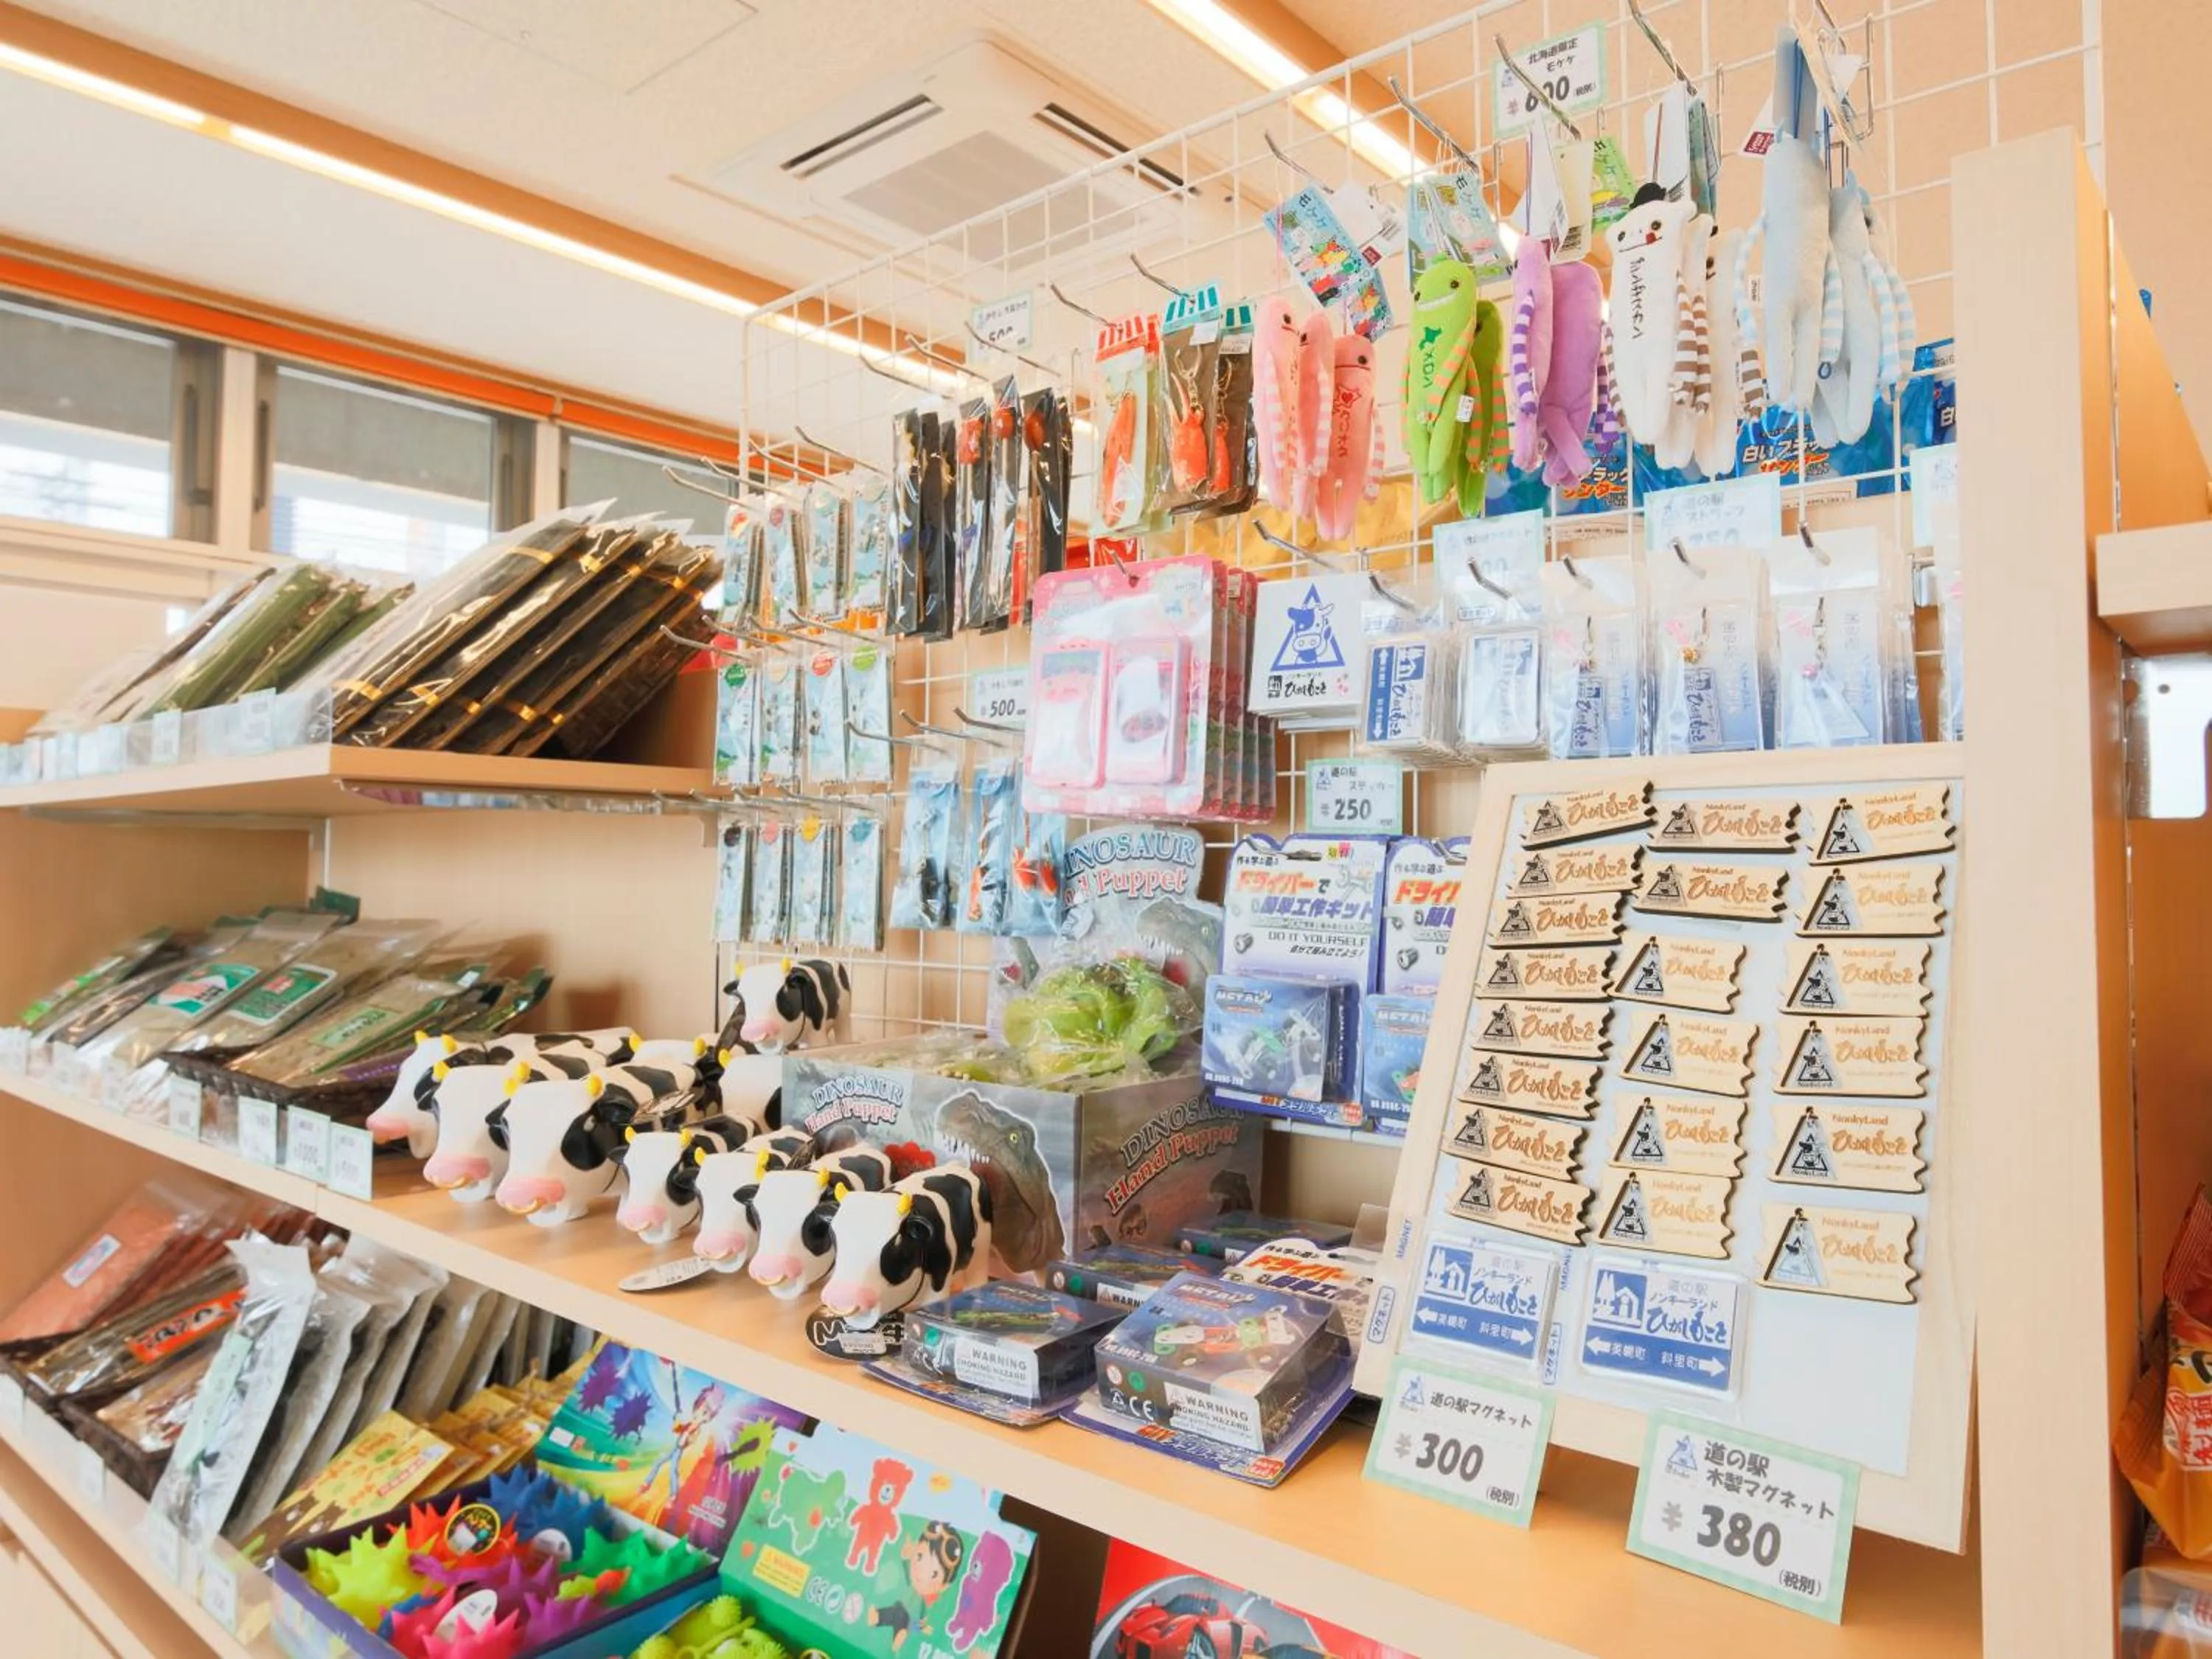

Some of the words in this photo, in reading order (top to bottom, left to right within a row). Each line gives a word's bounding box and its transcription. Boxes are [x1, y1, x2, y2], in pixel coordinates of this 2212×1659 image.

[1547, 55, 1576, 72] モケケ
[1940, 406, 1956, 428] 白
[1743, 439, 1820, 463] 白いブラッ
[990, 698, 1015, 718] 500
[1335, 798, 1371, 821] 250
[1065, 830, 1196, 880] INOSAUR
[1094, 867, 1187, 900] Puppet
[1260, 896, 1373, 920] 簡単工作キット
[1268, 931, 1285, 941] DO
[1290, 932, 1298, 942] IT
[1304, 933, 1368, 947] YOURSELF
[811, 1073, 904, 1110] DINOSAUR
[841, 1096, 897, 1125] Puppet
[1105, 1142, 1169, 1215] Hand
[1170, 1123, 1239, 1163] Puppet
[1395, 1219, 1412, 1259] MAGNET
[1474, 1266, 1534, 1284] ノンキーランド
[1668, 1279, 1708, 1292] 道の駅
[1469, 1279, 1537, 1315] ひがしもこと
[1649, 1292, 1719, 1312] ノンキーランド
[1372, 1291, 1392, 1337] マグネット
[1646, 1307, 1727, 1343] ひがしもこと
[972, 1347, 1027, 1370] WARNING
[1545, 1327, 1560, 1378] マグネット
[1660, 1351, 1698, 1370] 斜里町
[1186, 1395, 1249, 1422] WARNING
[1430, 1391, 1533, 1429] 道の駅マグネット
[1704, 1440, 1770, 1478] 道の駅
[1486, 1486, 1520, 1509] (税別)
[1706, 1468, 1834, 1520] 木製マグネット
[1697, 1504, 1781, 1568] 380
[1778, 1569, 1822, 1596] (税別)
